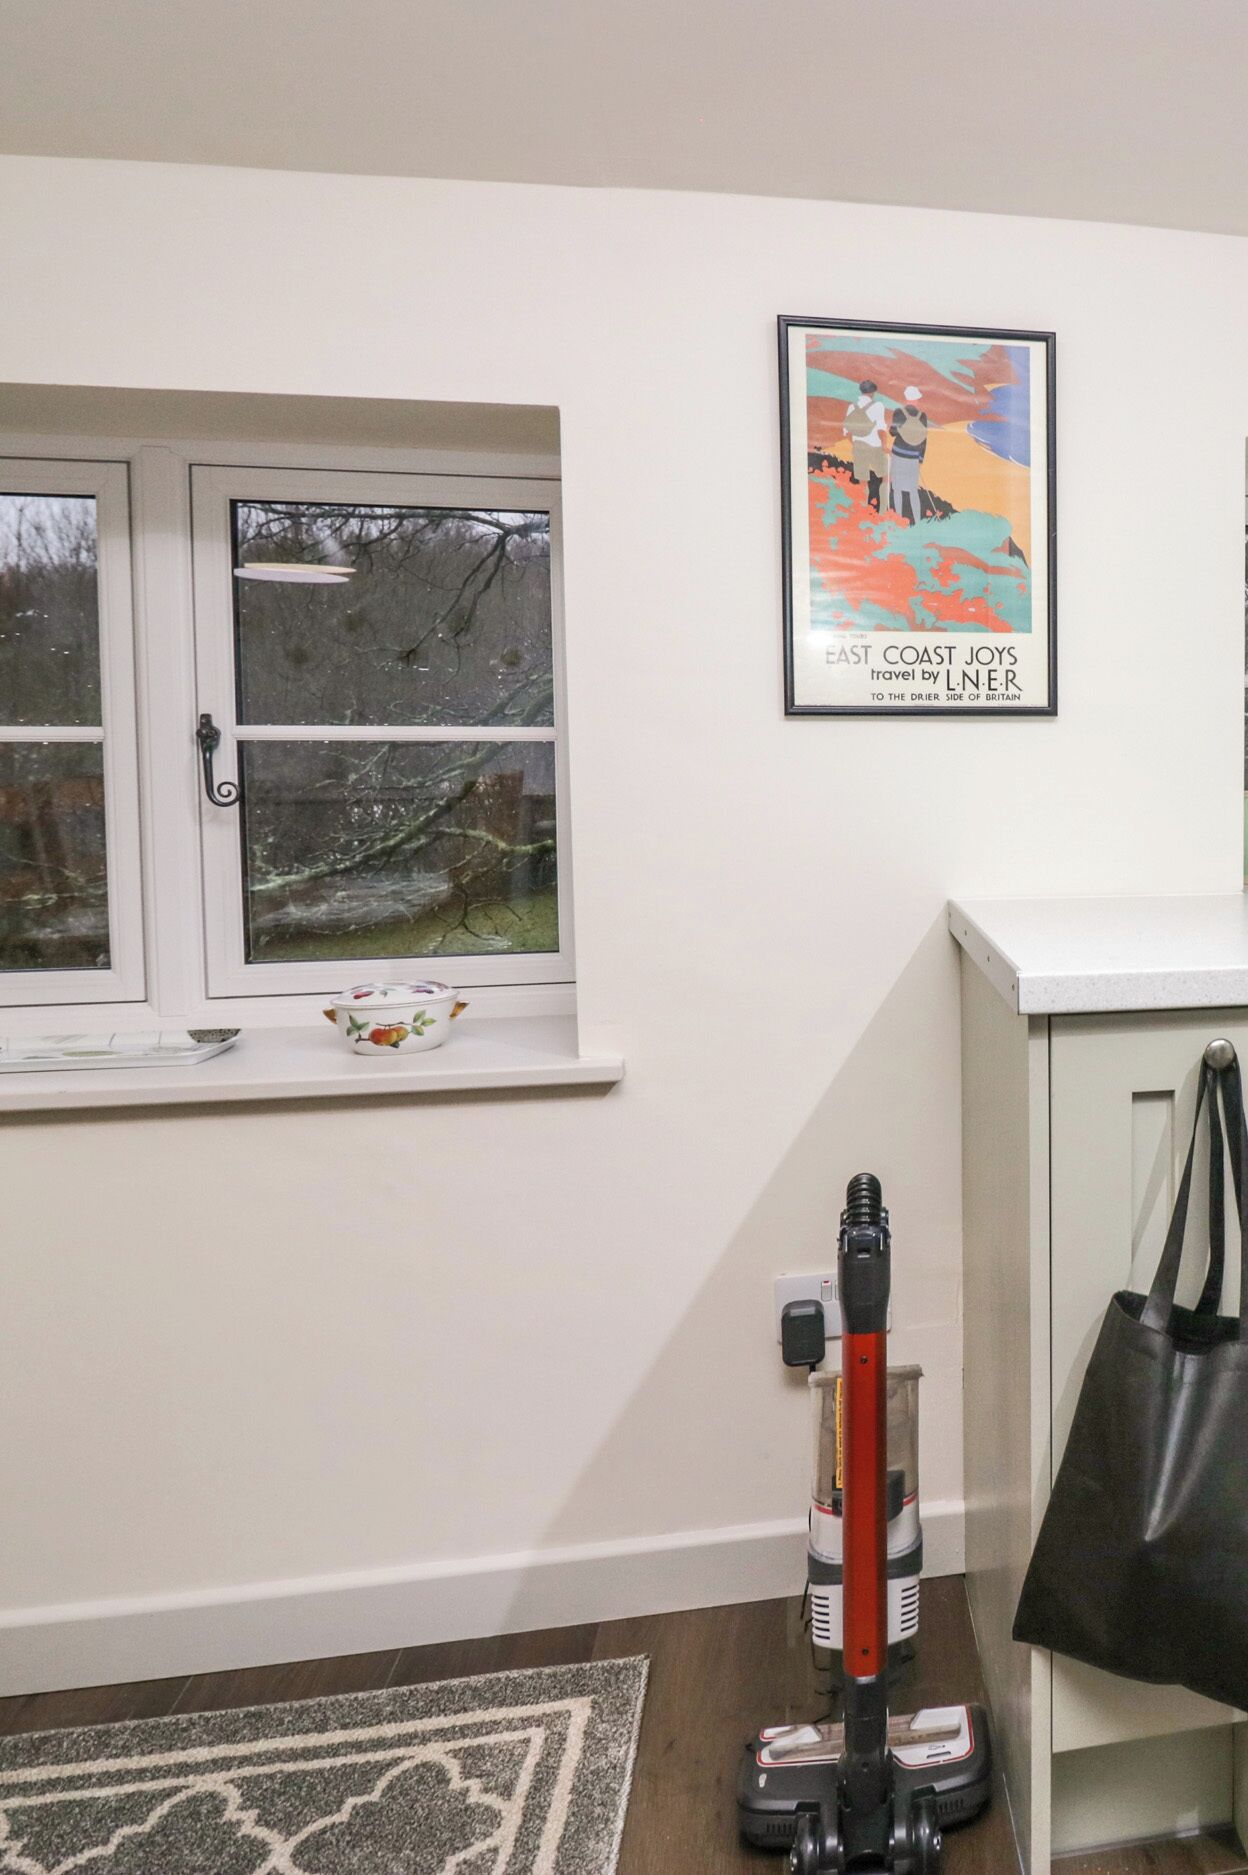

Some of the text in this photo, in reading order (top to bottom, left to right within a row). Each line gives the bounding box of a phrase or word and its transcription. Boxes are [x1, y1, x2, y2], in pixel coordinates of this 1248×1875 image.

[825, 644, 1018, 666] EAST COAST JOYS
[870, 668, 916, 681] travel
[921, 668, 941, 685] by
[871, 693, 1021, 702] TO THE DRIER SIDE OF BRITAIN
